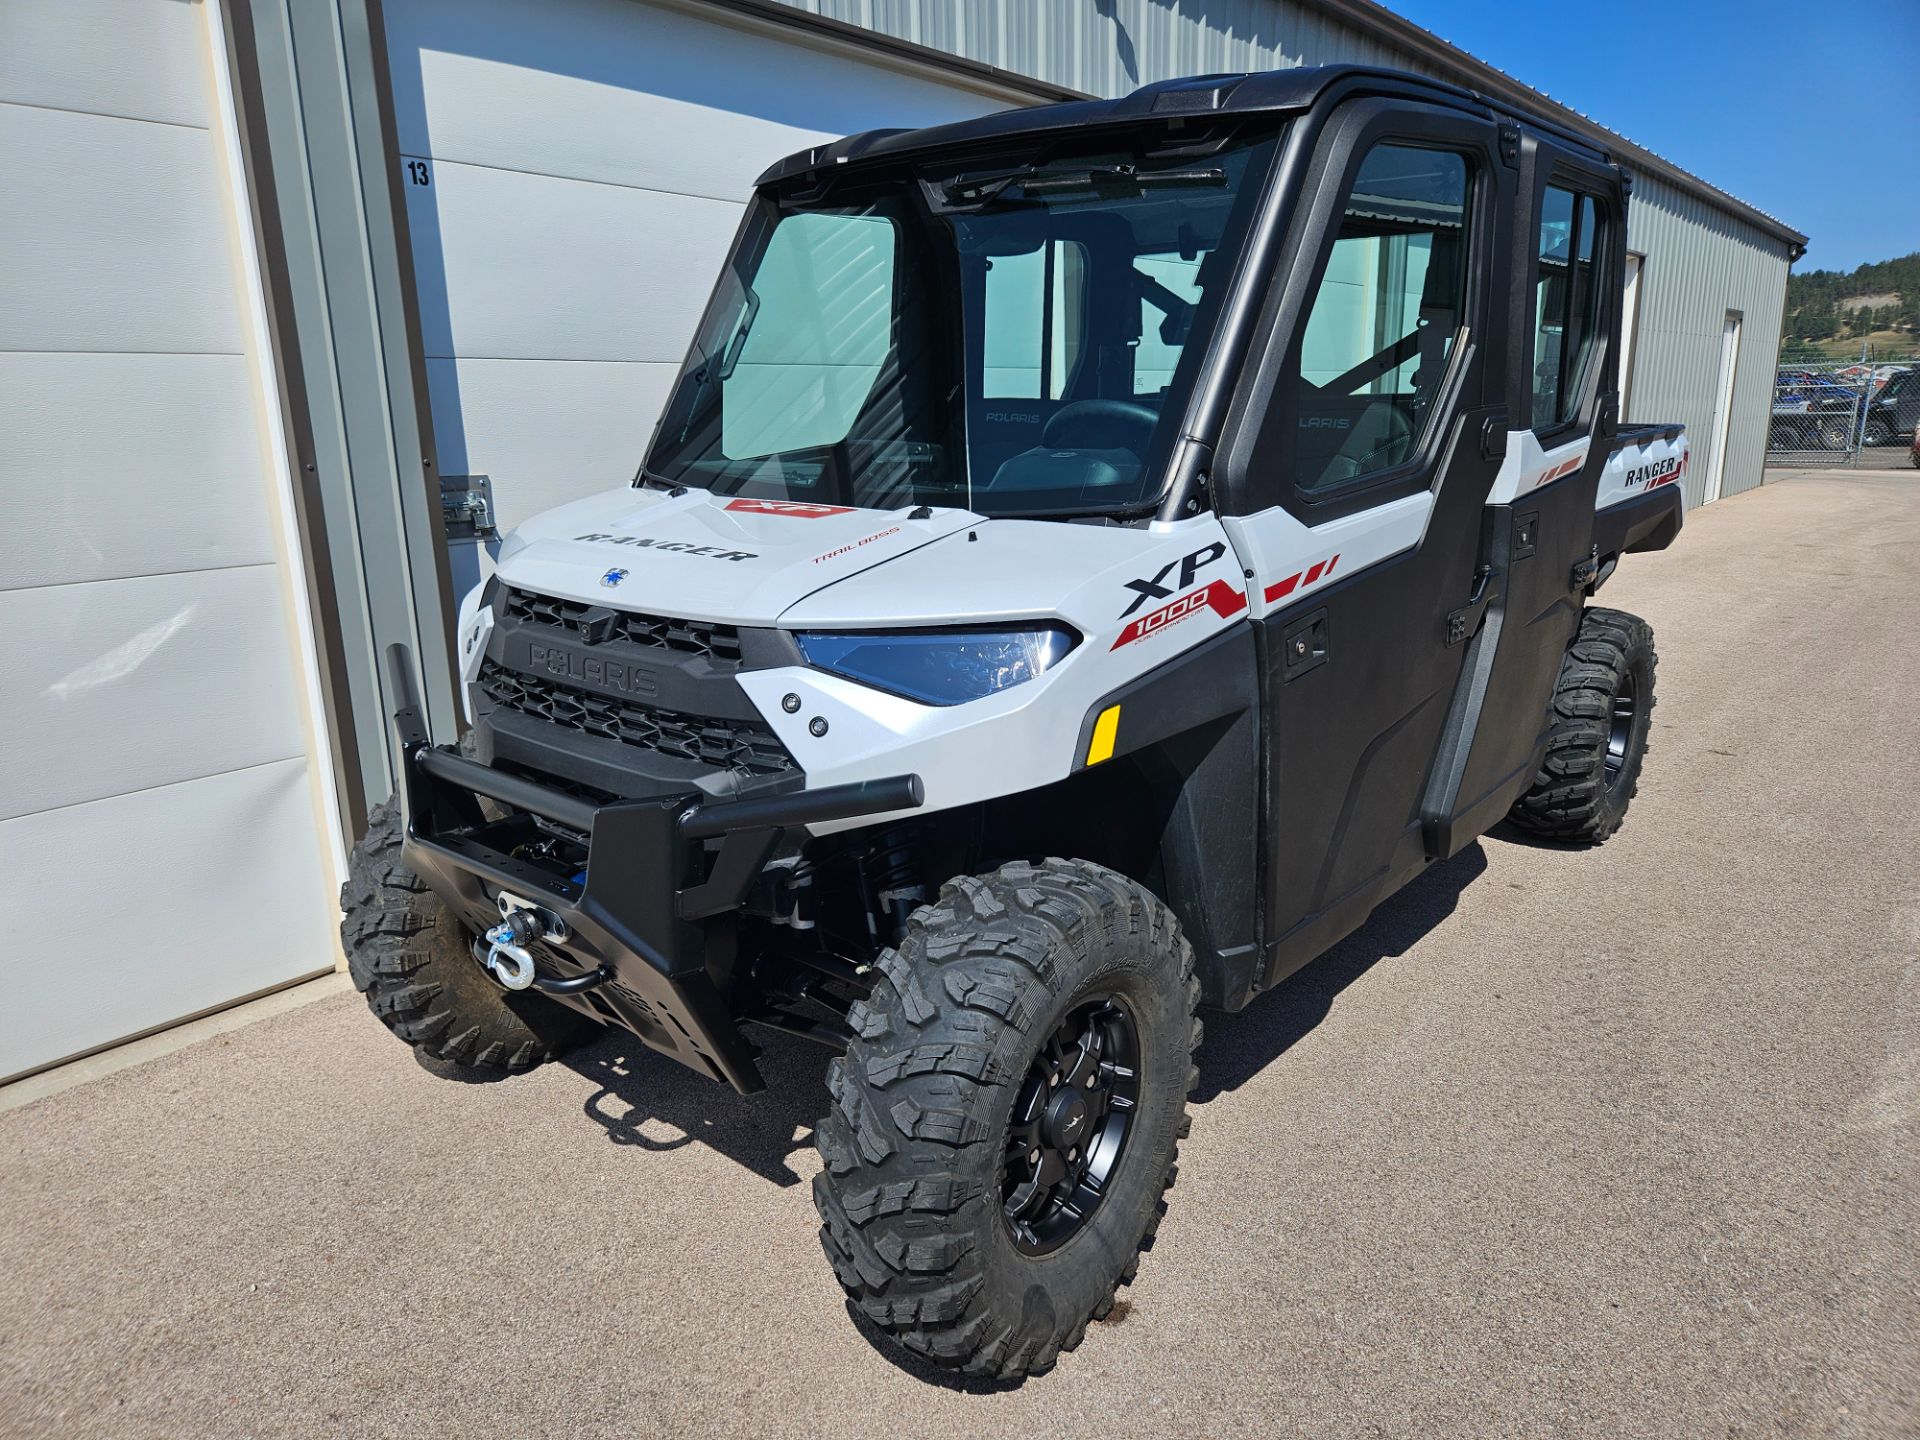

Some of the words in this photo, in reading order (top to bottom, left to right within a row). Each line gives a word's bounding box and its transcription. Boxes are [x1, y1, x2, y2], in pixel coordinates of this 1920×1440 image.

[407, 161, 429, 186] 13
[986, 412, 1041, 424] POLARIS
[1298, 417, 1351, 429] LARIS
[1624, 457, 1675, 487] RANGER
[736, 501, 833, 513] XP
[573, 533, 760, 562] RANGER
[811, 544, 857, 564] TRAIL
[858, 526, 901, 547] BOSS
[1117, 540, 1227, 621] XP
[1135, 587, 1211, 636] 1000
[529, 642, 658, 698] POLARIS
